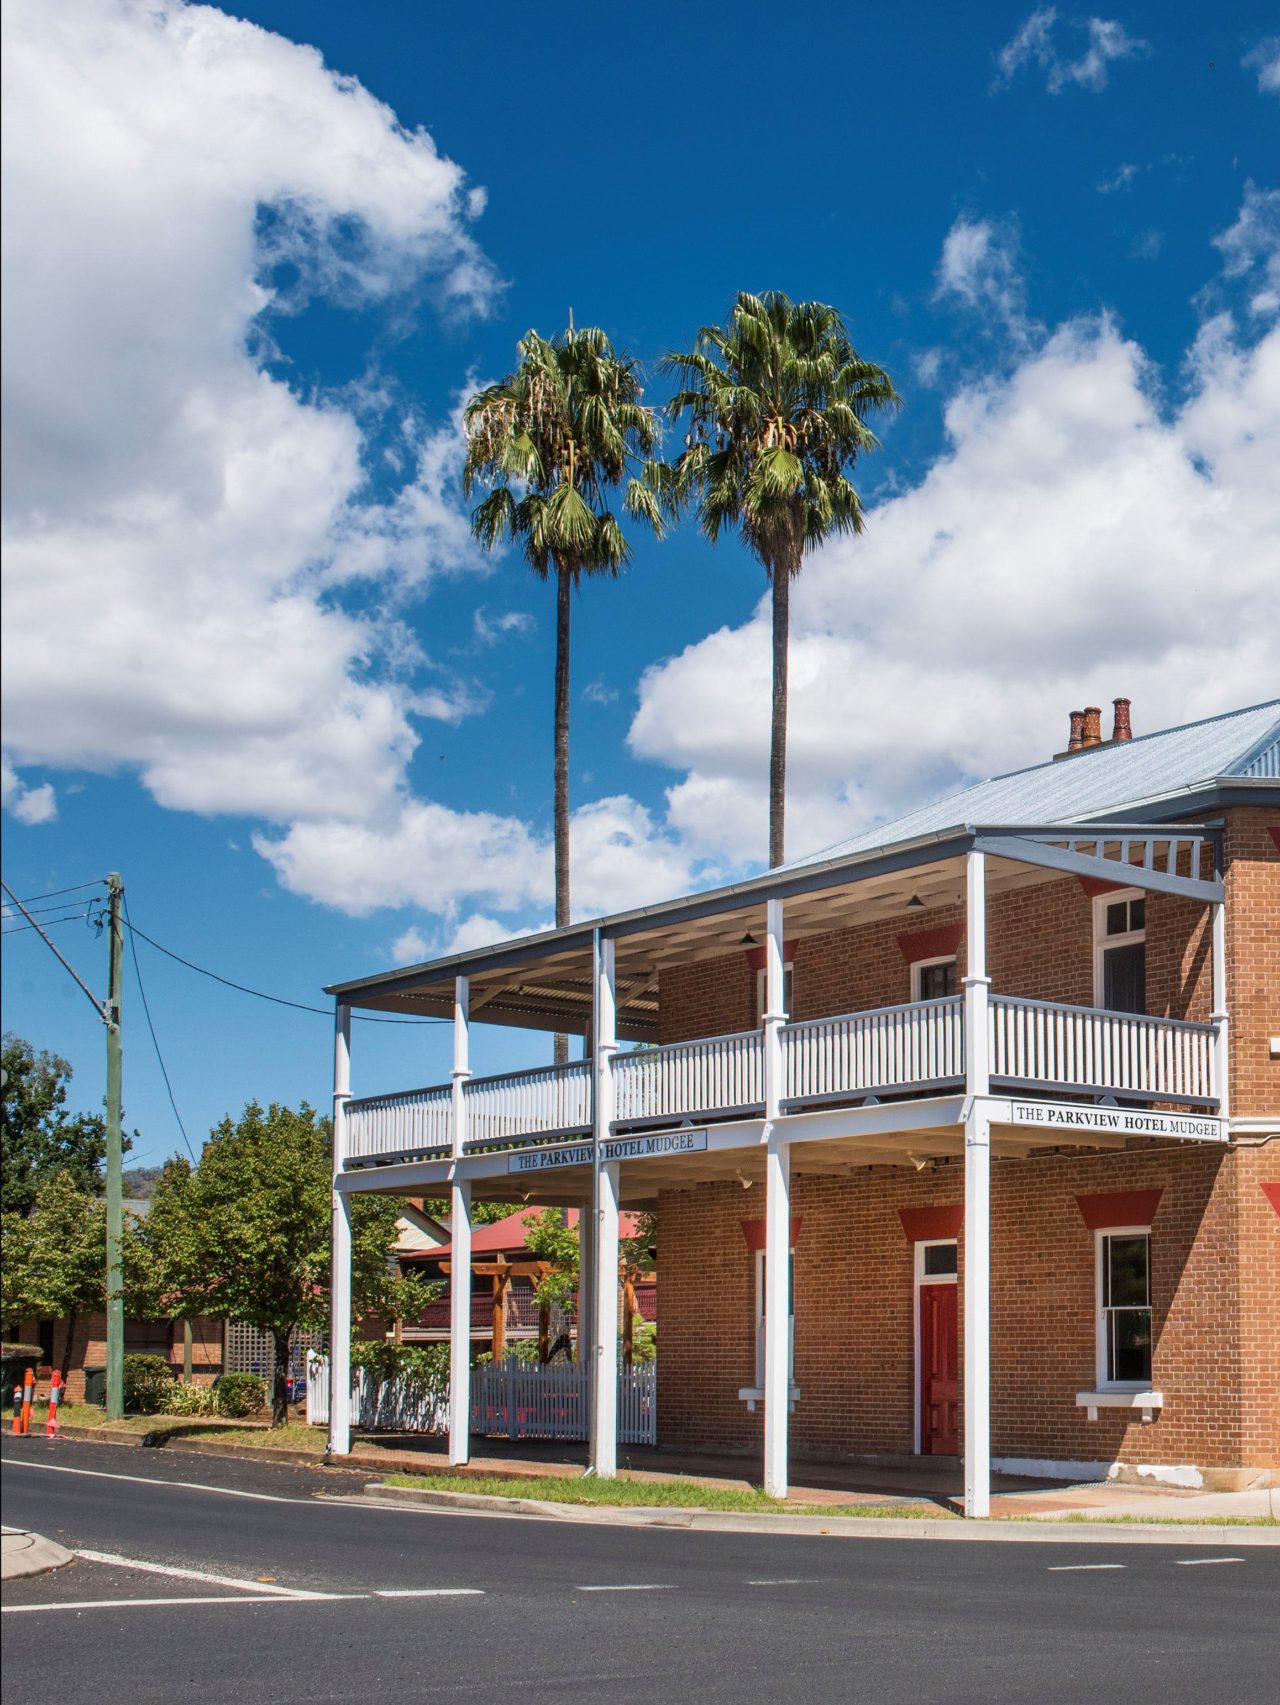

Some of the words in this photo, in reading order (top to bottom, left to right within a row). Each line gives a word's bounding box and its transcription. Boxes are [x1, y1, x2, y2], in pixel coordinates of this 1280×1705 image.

[1017, 1107, 1044, 1121] THE
[1047, 1109, 1120, 1128] PARKVIEW
[1124, 1117, 1168, 1132] HOTEL
[1170, 1120, 1218, 1136] MUDGEE
[518, 1154, 538, 1169] THE
[605, 1140, 644, 1159] HOTEL
[645, 1134, 694, 1153] MUDGEE
